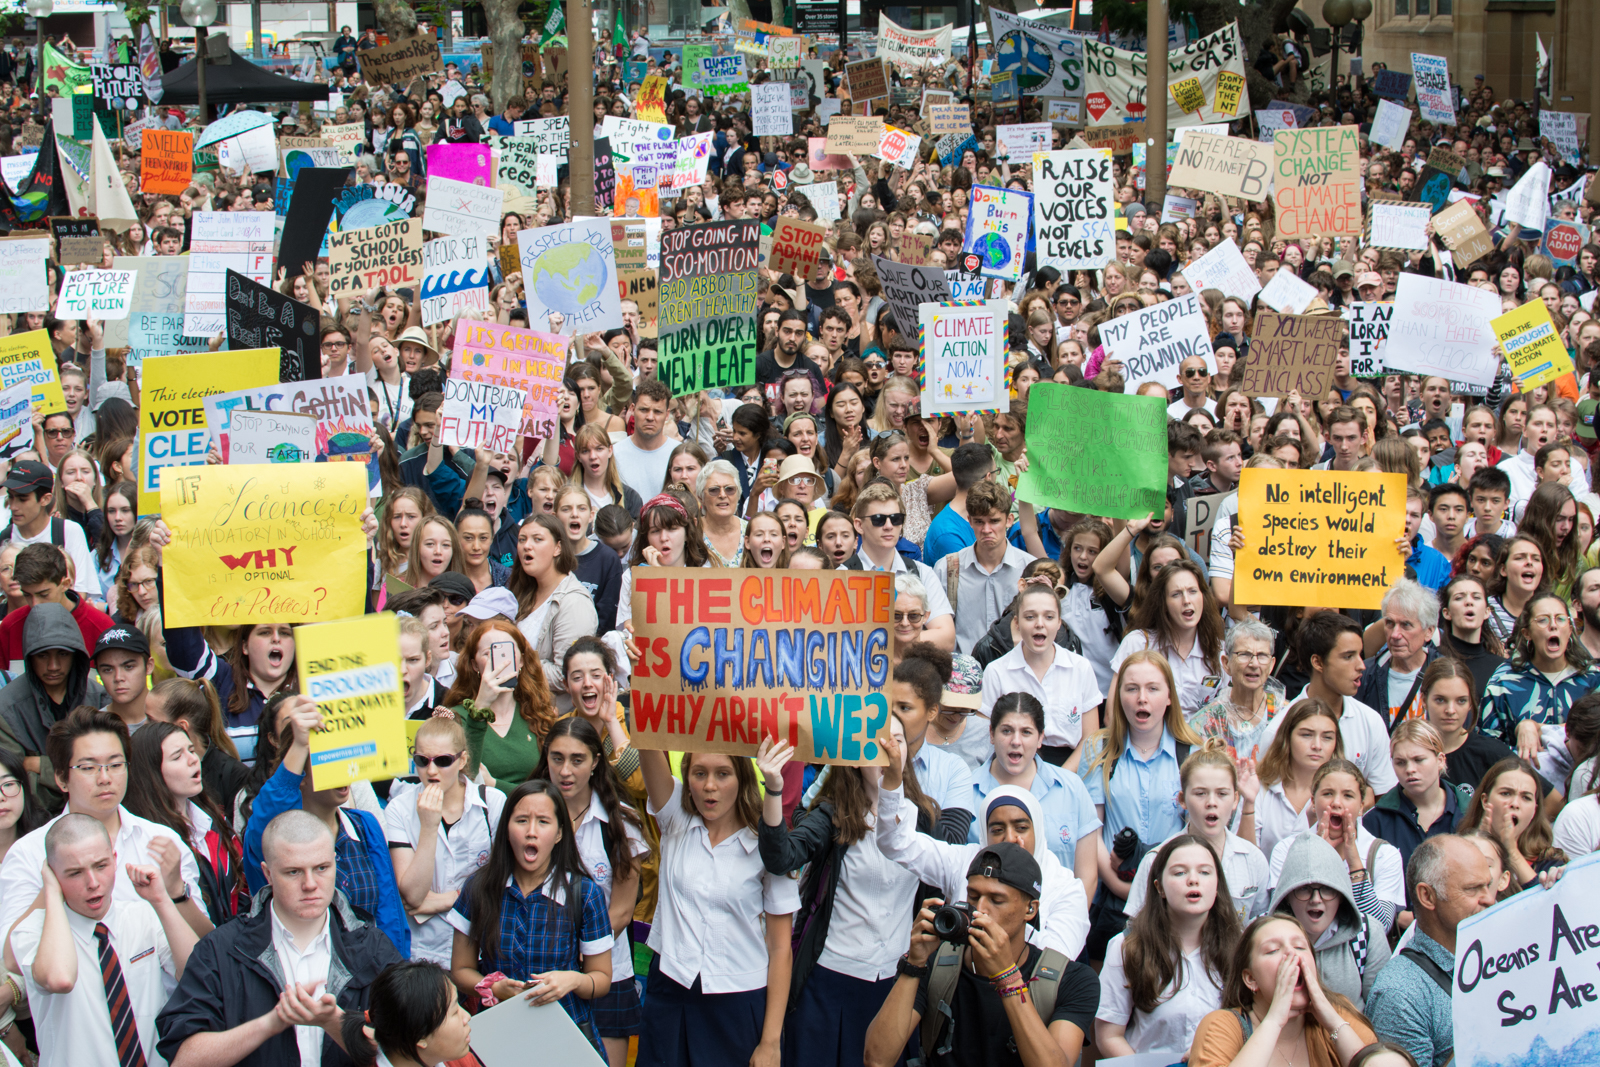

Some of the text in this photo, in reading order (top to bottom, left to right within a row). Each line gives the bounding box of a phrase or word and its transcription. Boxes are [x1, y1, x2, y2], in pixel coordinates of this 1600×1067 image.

[887, 40, 914, 57] CLIMATE
[908, 35, 938, 48] CHANGE
[1085, 24, 1236, 58] NO COAL!
[358, 53, 377, 68] The
[1087, 43, 1238, 78] NO GAS!
[1412, 53, 1447, 67] Economics
[113, 65, 142, 82] OUR
[367, 69, 391, 85] Why
[1218, 73, 1245, 85] DON'T
[1415, 71, 1446, 83] CLIMATE
[93, 79, 143, 98] FUTURE
[1172, 79, 1198, 91] LAND
[1174, 85, 1200, 99] RIGHTS
[1217, 82, 1242, 94] FRACK
[1417, 79, 1447, 91] CHANGE
[1218, 91, 1236, 102] THE
[1220, 102, 1237, 113] NT
[146, 132, 191, 155] SMELLS
[499, 136, 539, 155] Speak
[635, 140, 679, 152] THE PLANET
[680, 136, 697, 152] NO
[1274, 129, 1359, 156] SYSTEM
[514, 152, 535, 169] The
[675, 157, 697, 172] NEW
[1041, 159, 1110, 183] RAISE
[1279, 152, 1354, 177] CHANGE
[34, 171, 53, 186] NO
[141, 170, 192, 190] pollution
[672, 167, 701, 190] COAL
[1179, 148, 1268, 196] NO PLANET B
[1297, 172, 1333, 187] NOT
[1054, 182, 1097, 199] OUR
[1276, 183, 1357, 209] CLIMATE
[1039, 197, 1108, 222] VOICES
[1278, 203, 1359, 236] CHANGE
[1435, 208, 1468, 231] Scomo
[330, 220, 410, 248] WE'LL GO TO
[662, 223, 760, 255] STOP GOING IN
[779, 225, 823, 248] STOP
[1039, 221, 1114, 241] NOT SEA
[1462, 224, 1476, 238] big
[1551, 230, 1580, 242] STOP
[350, 237, 409, 261] SCHOOL
[614, 247, 645, 259] START
[771, 242, 820, 266] ADANI
[1047, 239, 1104, 260] LEVELS
[1455, 238, 1487, 264] No No
[1548, 240, 1580, 253] ADANI
[330, 247, 424, 275] IF YOU ARE LESS
[662, 247, 758, 283] SCO-MOTION
[68, 271, 130, 284] NOT YOUR
[330, 264, 414, 291] OF TOOL
[65, 281, 130, 297] FUTURE
[659, 278, 687, 305] BAD
[66, 298, 124, 311] TO RUIN
[659, 291, 757, 328] AREN'T HEALTHY
[934, 316, 994, 338] CLIMATE
[1104, 296, 1198, 347] MY PEOPLE
[1499, 320, 1533, 342] END THE
[466, 325, 566, 362] ITS GETTING
[659, 316, 745, 357] TURN OVER
[1138, 326, 1173, 351] ARE
[1505, 324, 1552, 351] DROUGHT
[1521, 333, 1557, 357] CLIMATE
[22, 350, 40, 360] FOR
[941, 339, 988, 358] ACTION
[1513, 350, 1544, 368] ACTION
[1, 361, 42, 377] CLEAN
[658, 343, 756, 396] NEW LEAF
[946, 360, 983, 379] NOW!
[149, 386, 178, 402] This
[490, 386, 527, 410] BURN
[149, 407, 204, 428] VOTE
[470, 403, 498, 423] MY
[232, 414, 310, 436] STOP DENYING
[440, 416, 516, 454] FUTURE
[232, 443, 309, 460] OUR EARTH
[214, 476, 326, 527] Science
[1266, 482, 1386, 514] No intelligent
[1263, 512, 1375, 536] species would
[218, 545, 297, 571] WHY
[1258, 536, 1368, 560] destroy their
[244, 569, 295, 582] OPTIONAL
[1253, 566, 1392, 587] own environment.
[635, 574, 891, 626] THE CLIMATE
[633, 626, 889, 693] IS CHANGING
[309, 667, 395, 698] DROUGHT
[337, 691, 398, 714] CLIMATE
[631, 689, 889, 761] WHY AREN'T WE?
[1457, 903, 1600, 994] Oceans Are
[1496, 966, 1599, 1028] So Are
